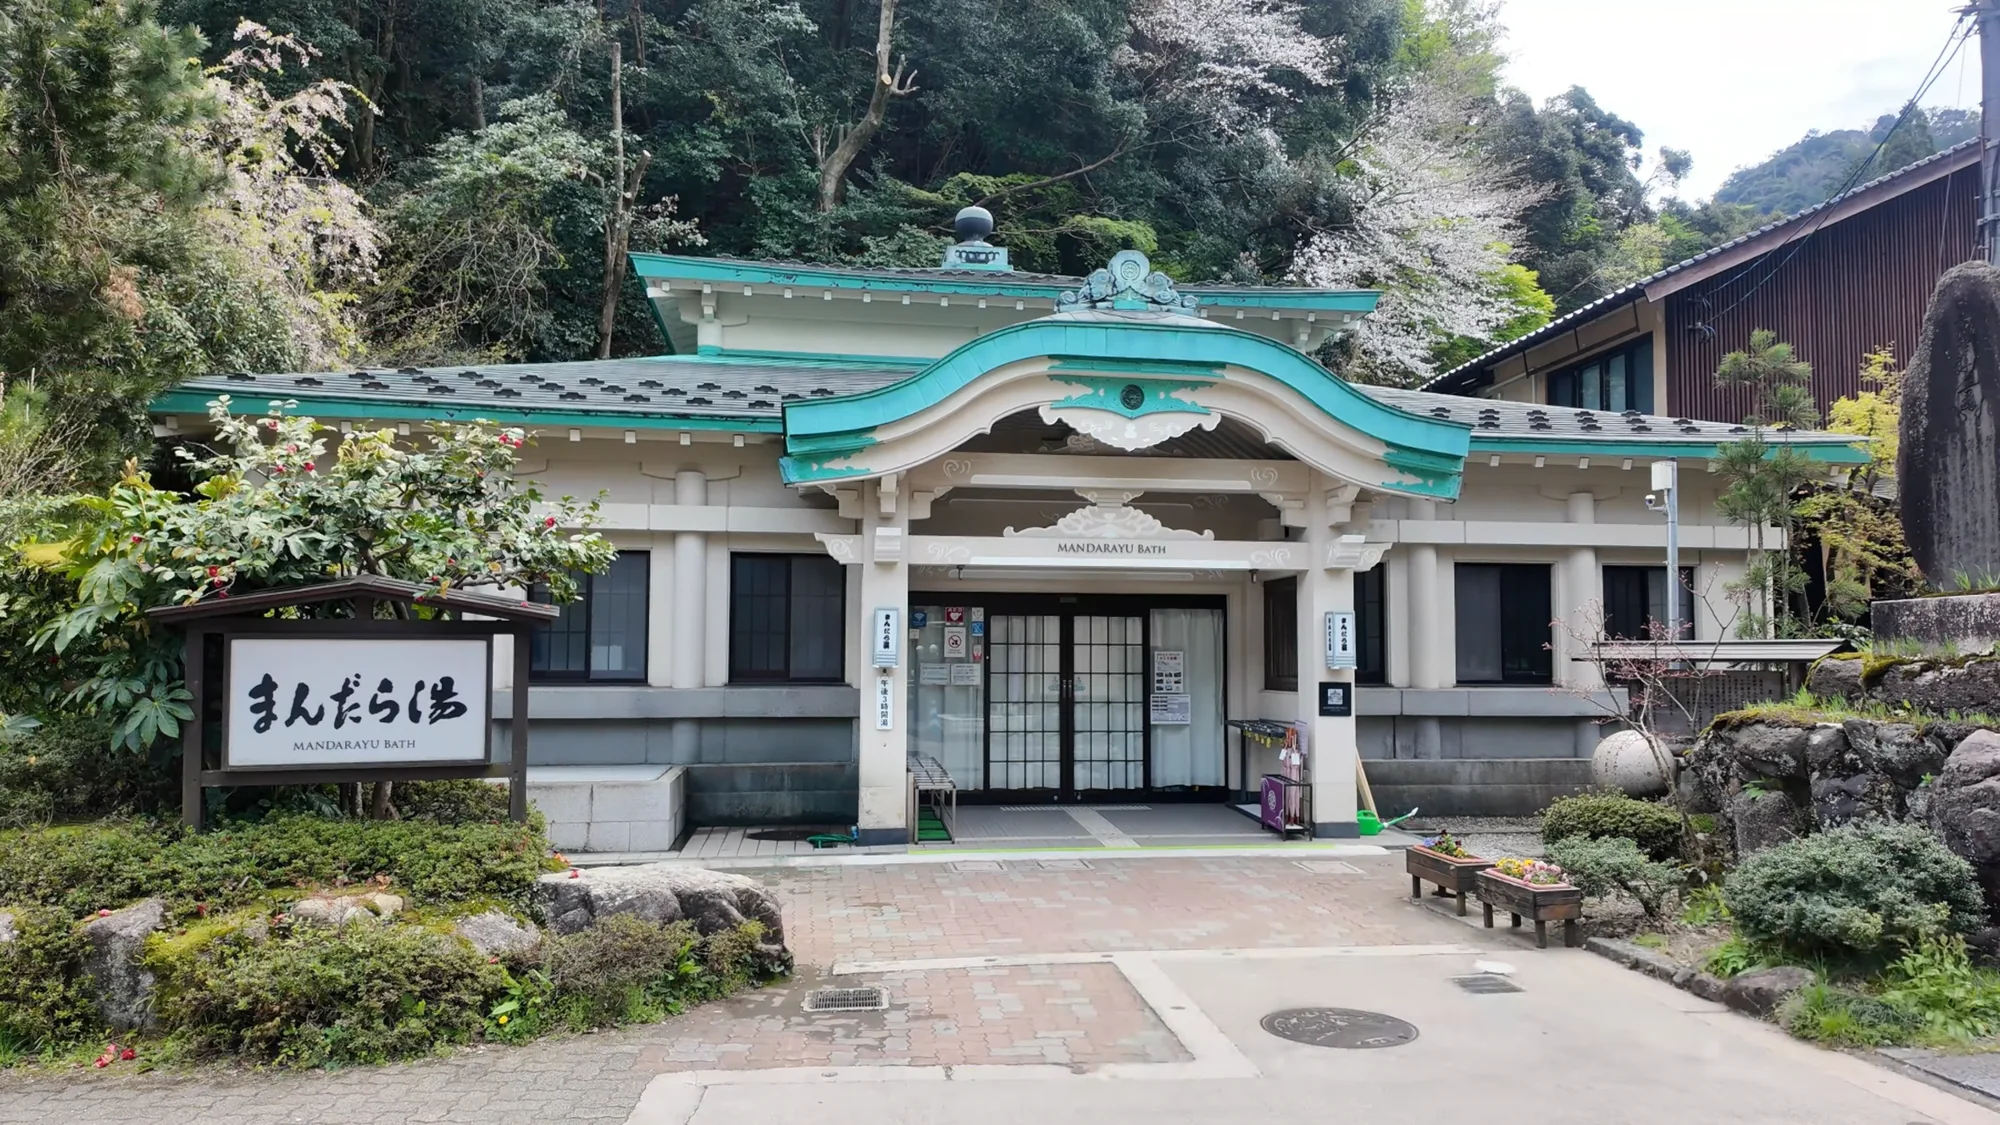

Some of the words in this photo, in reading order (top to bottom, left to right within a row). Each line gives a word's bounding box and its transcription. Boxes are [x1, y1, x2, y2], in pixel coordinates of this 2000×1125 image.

[1057, 543, 1134, 554] MANDARAYU
[1137, 544, 1166, 554] BATH
[248, 673, 468, 734] まんだら湯
[292, 739, 381, 751] MANDARAYU
[383, 739, 416, 749] BATH
